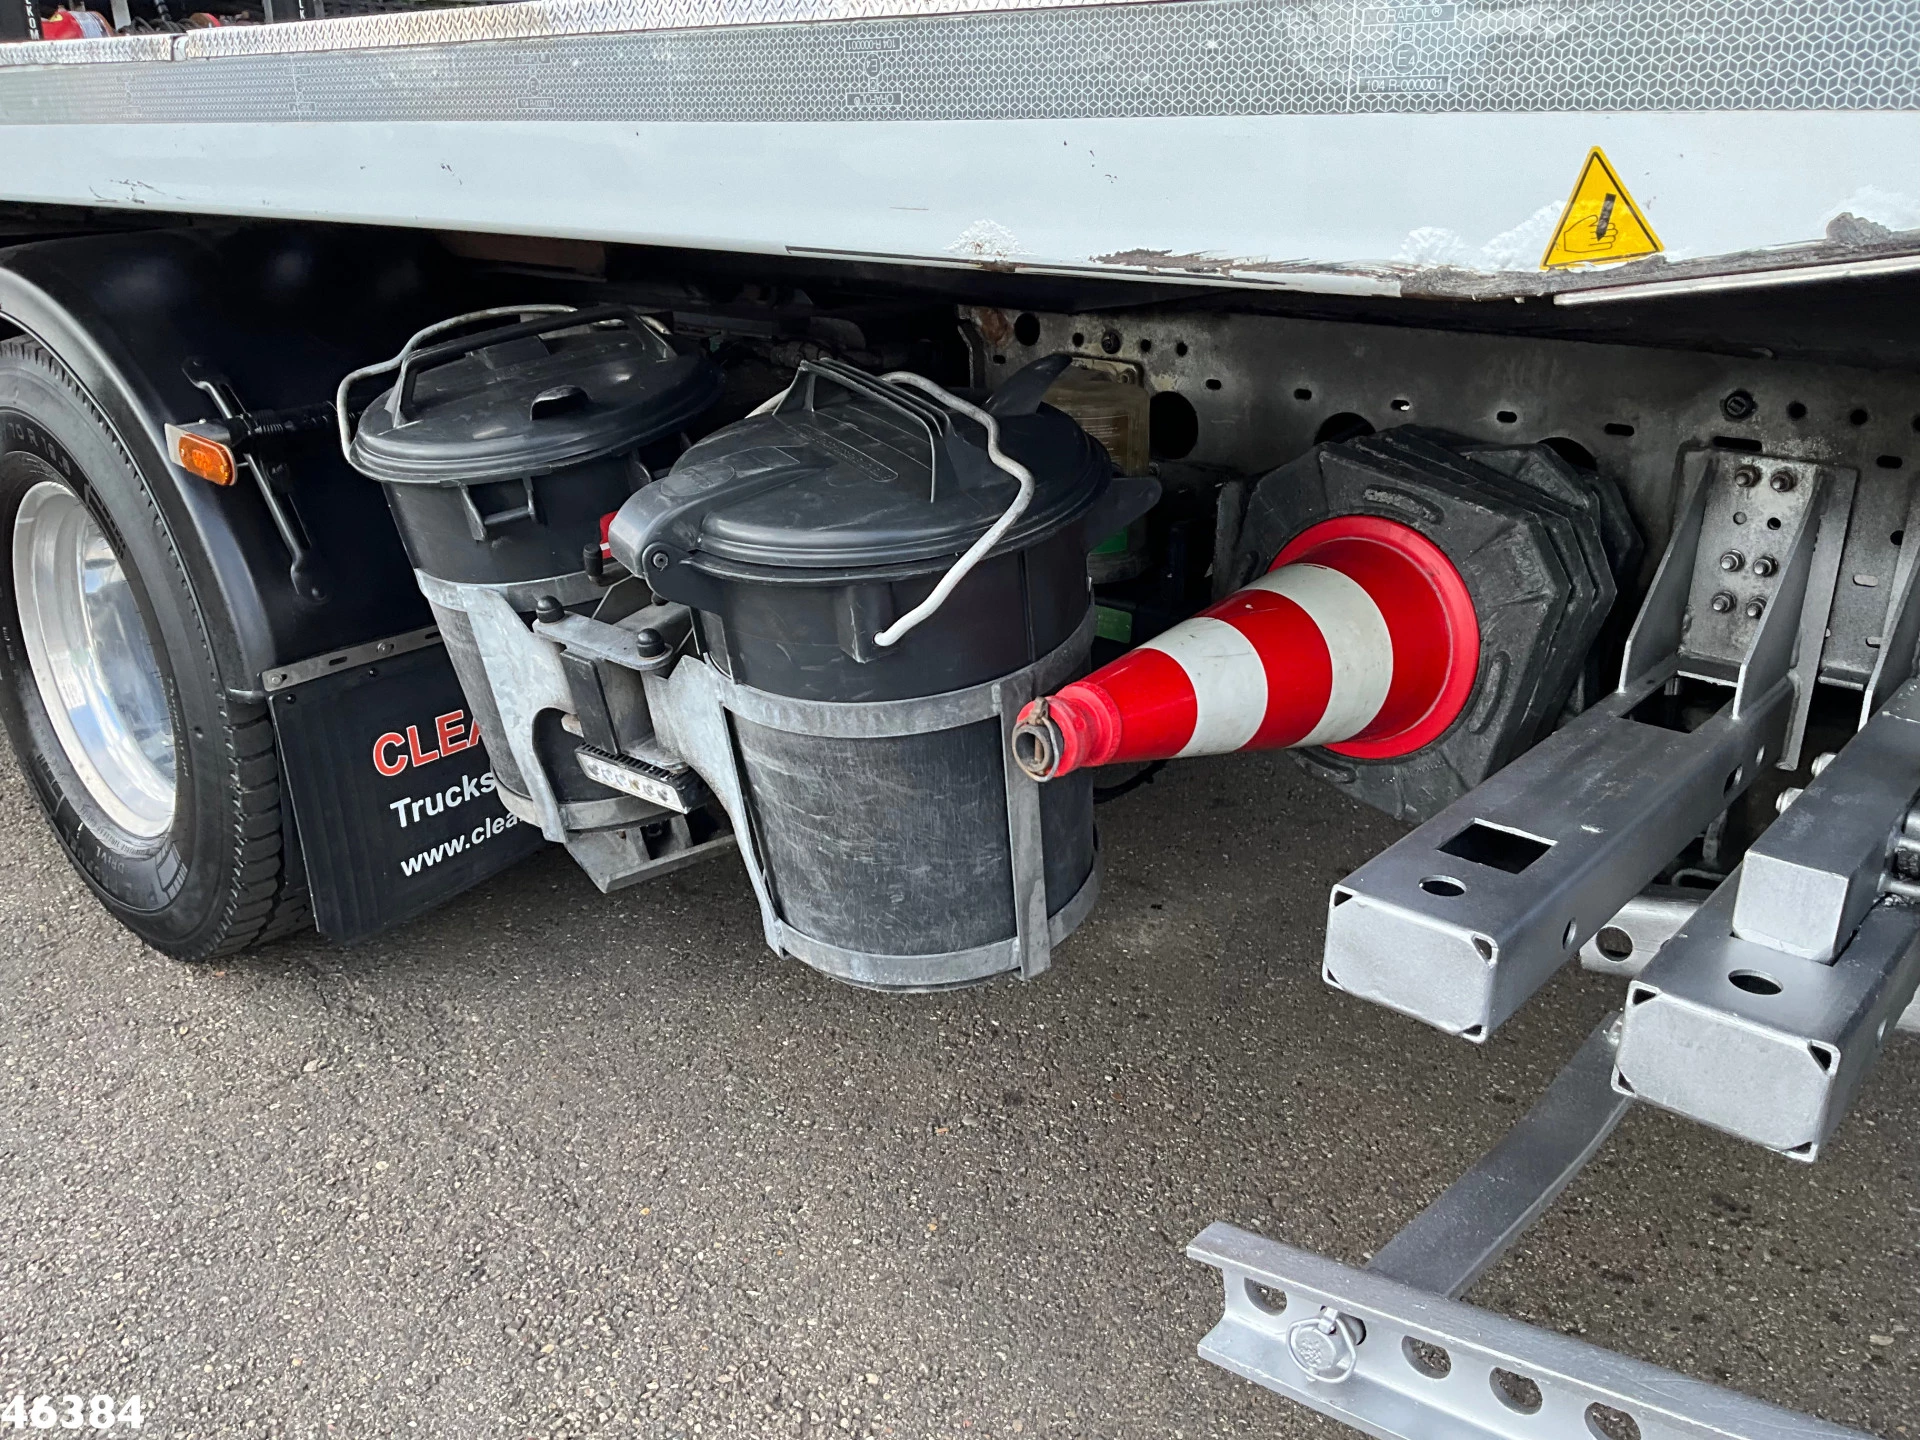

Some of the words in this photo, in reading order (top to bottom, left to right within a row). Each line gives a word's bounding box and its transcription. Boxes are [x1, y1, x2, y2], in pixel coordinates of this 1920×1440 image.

[1366, 79, 1385, 92] 104
[389, 771, 496, 828] Trucks
[400, 811, 523, 877] www.clea
